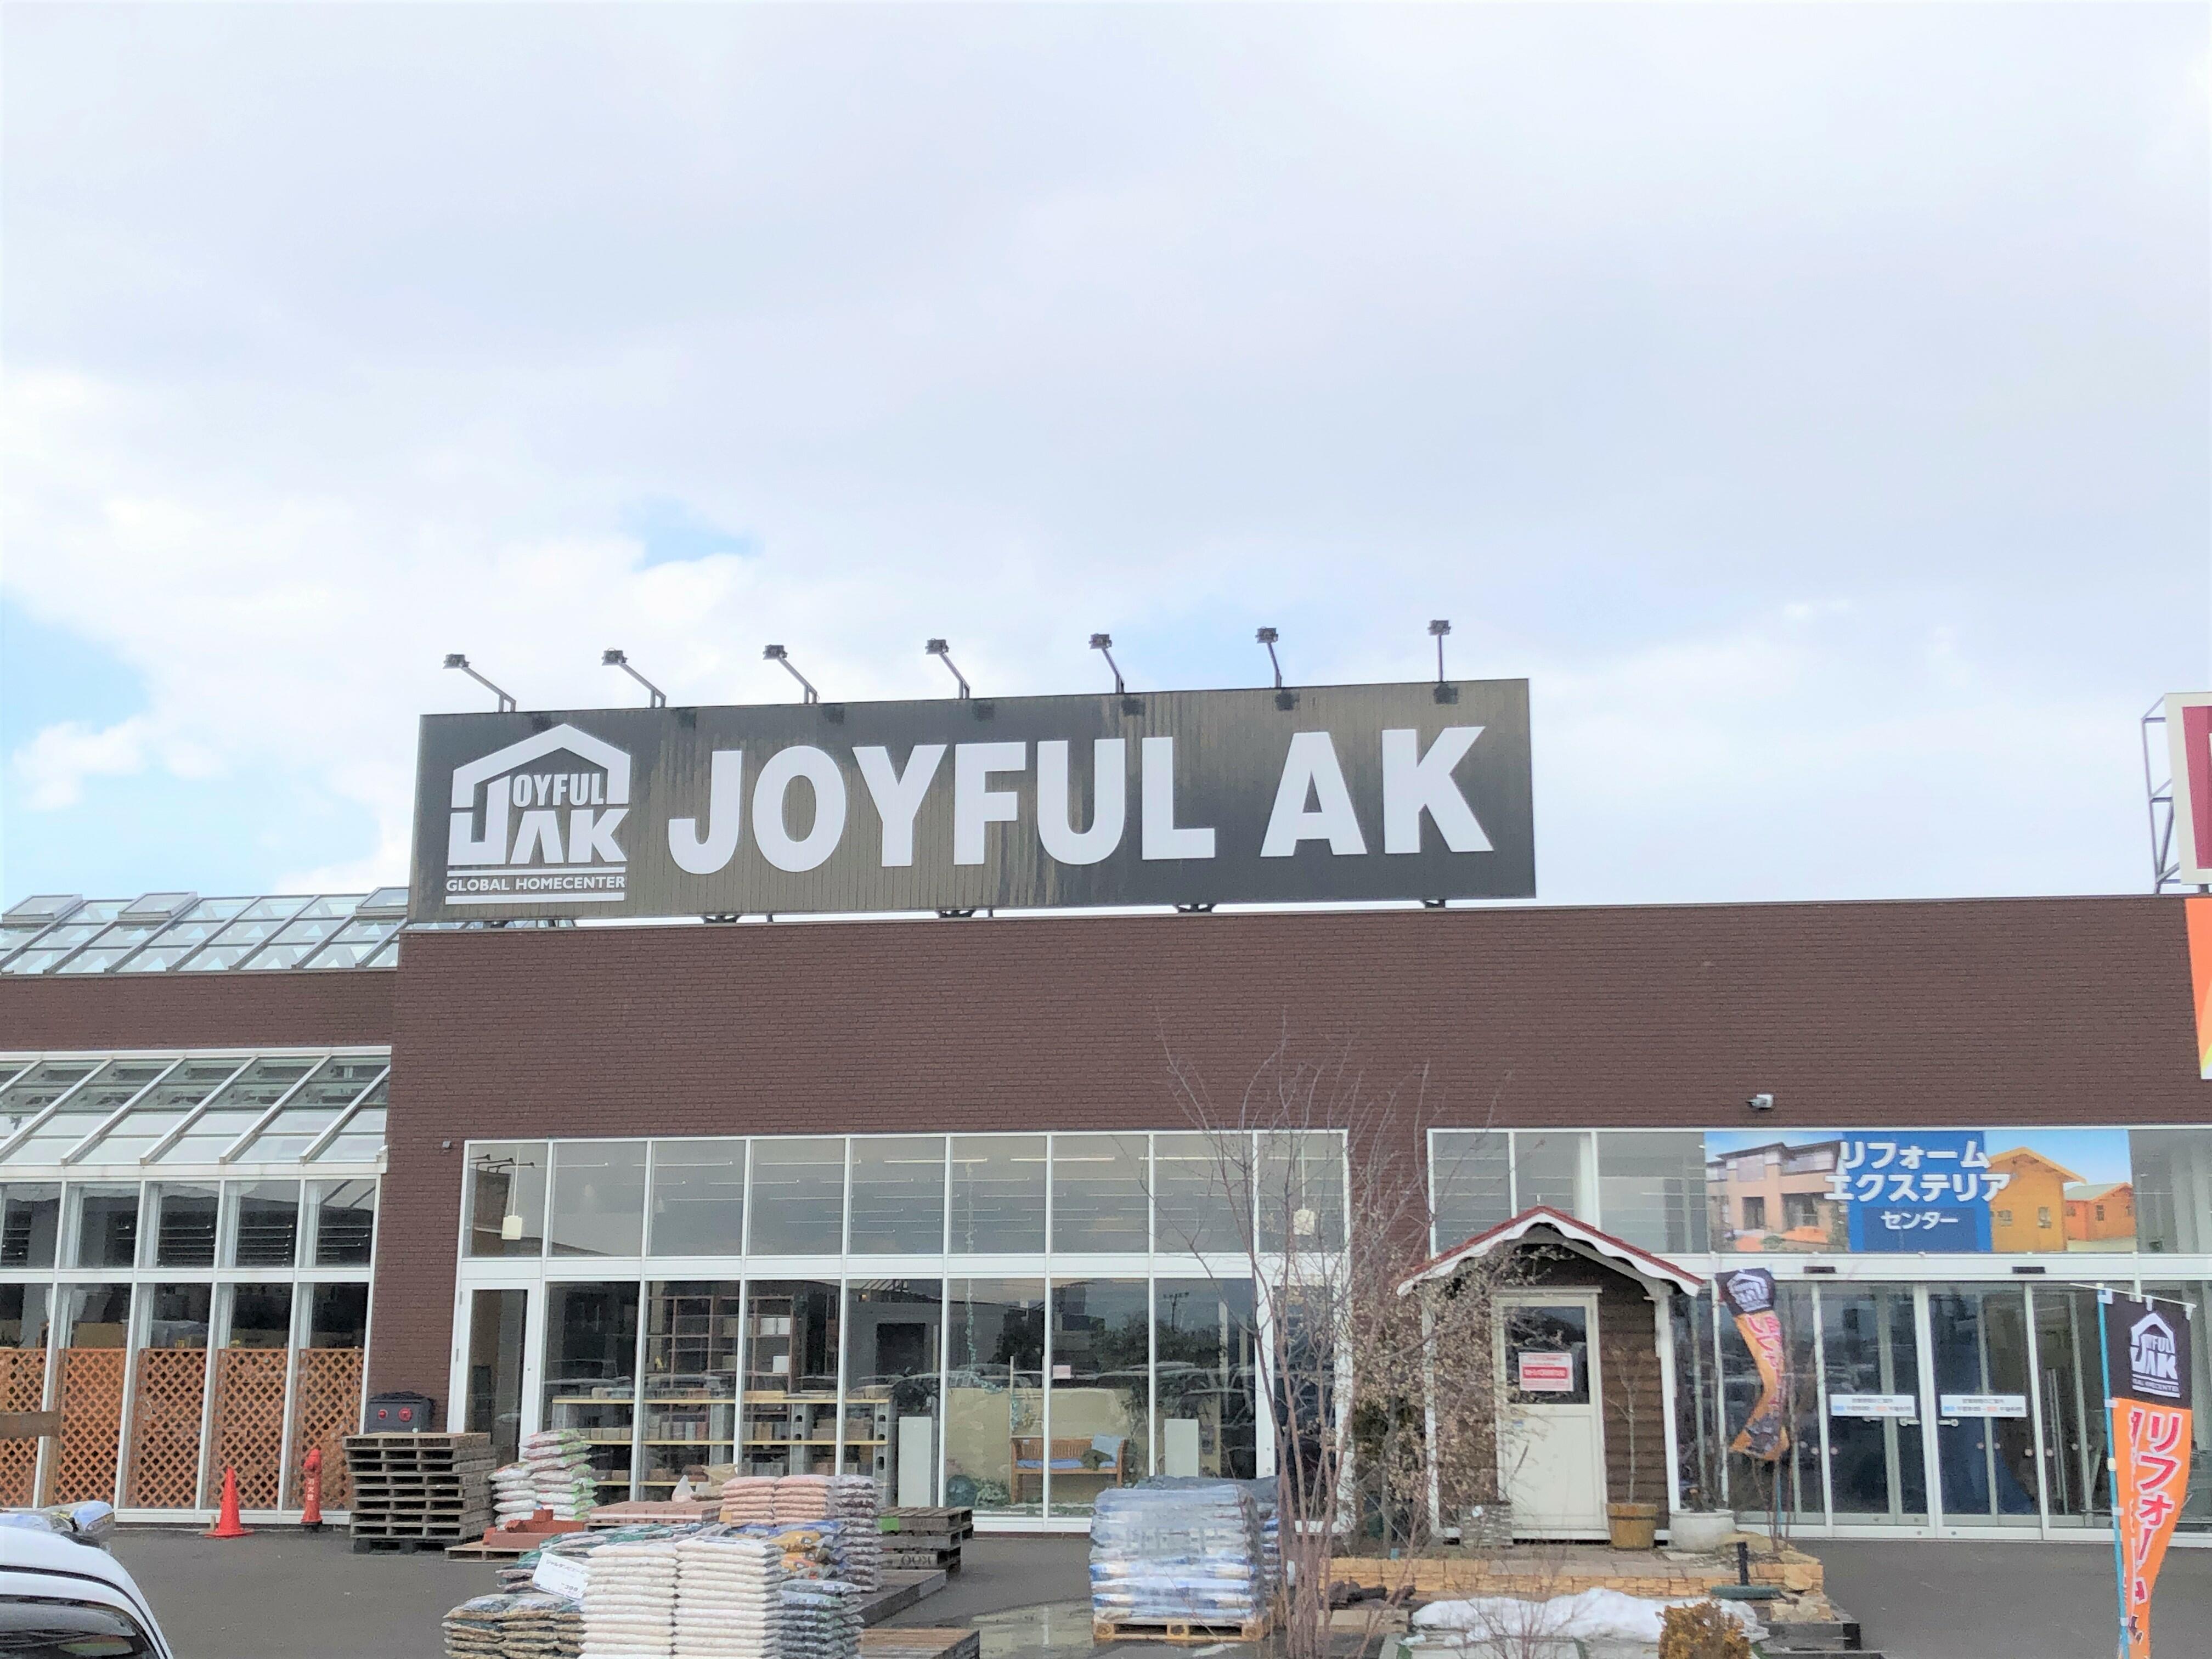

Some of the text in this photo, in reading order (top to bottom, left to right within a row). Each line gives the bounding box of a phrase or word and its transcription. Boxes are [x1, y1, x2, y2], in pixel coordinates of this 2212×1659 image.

[668, 725, 1494, 875] JOYFUL AK
[445, 876, 626, 892] GLOBAL HOMECENTER
[1838, 1139, 1991, 1170] リフォーム
[1824, 1173, 2010, 1202] エクステリア
[1880, 1210, 1959, 1230] センター
